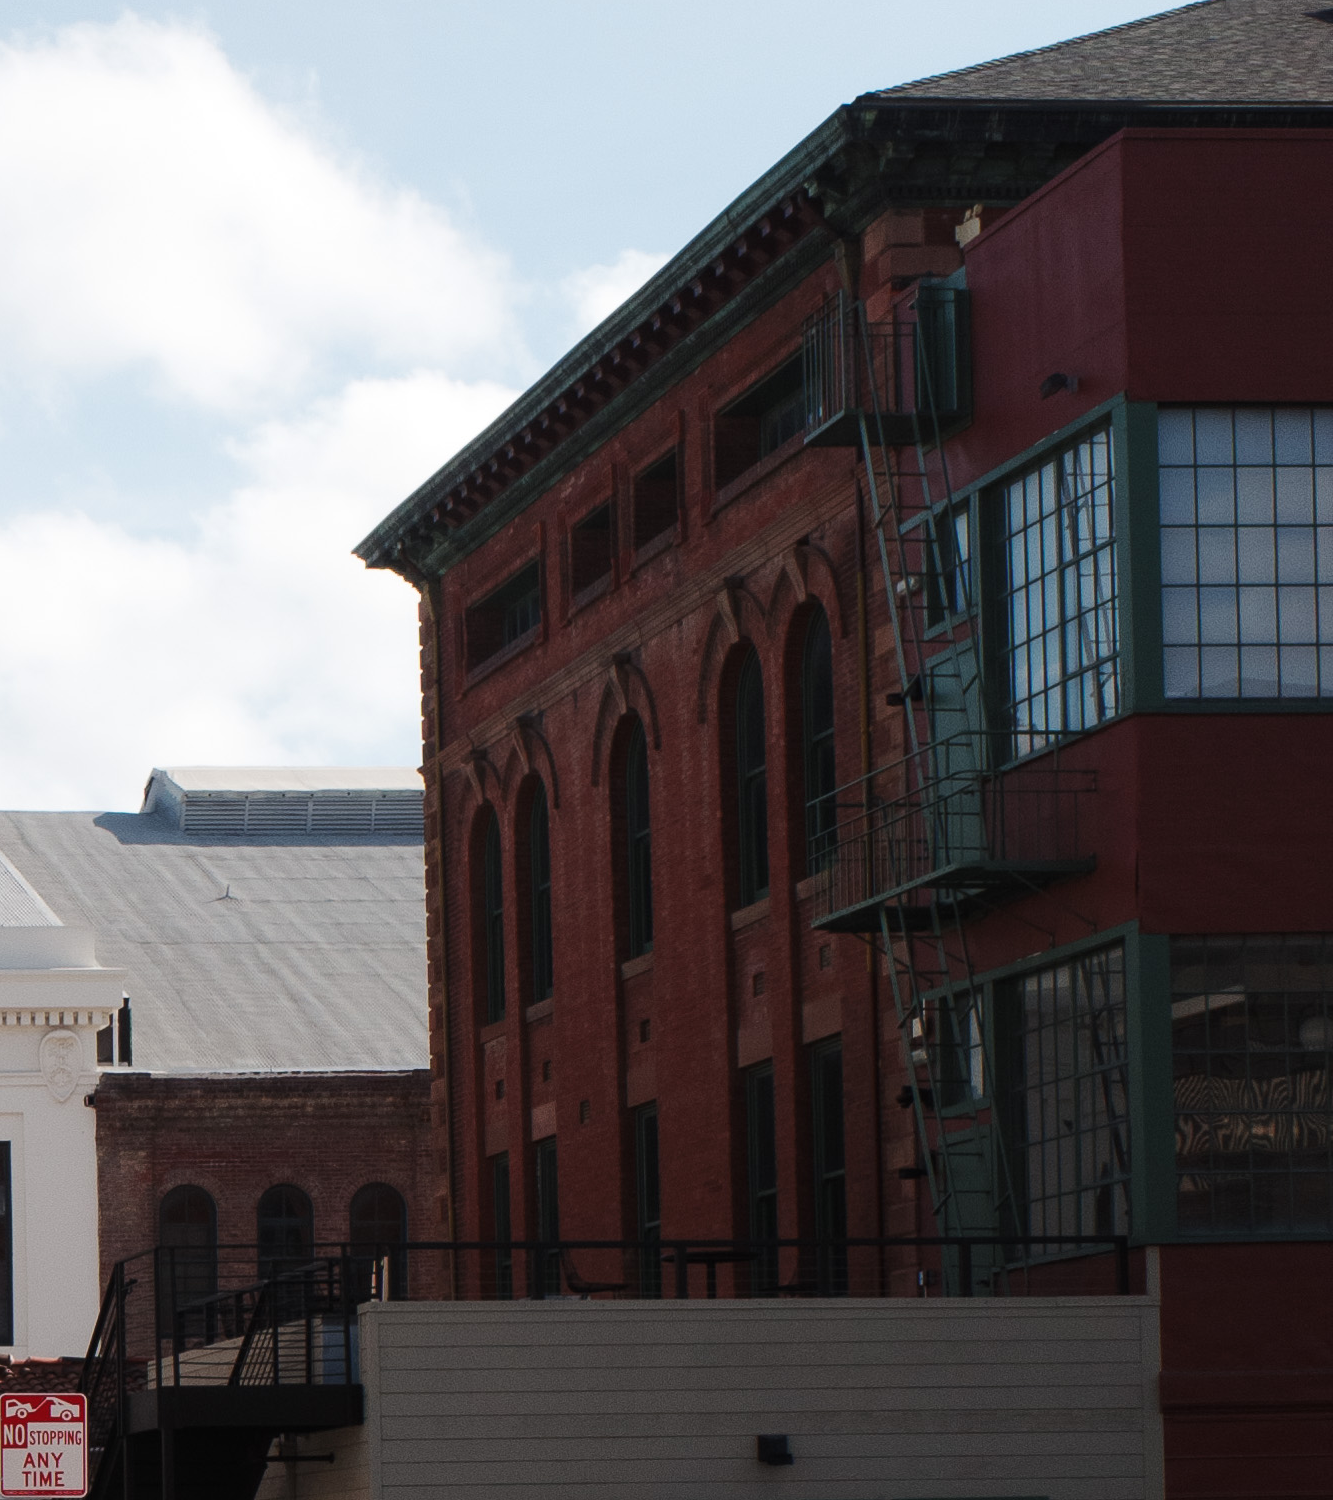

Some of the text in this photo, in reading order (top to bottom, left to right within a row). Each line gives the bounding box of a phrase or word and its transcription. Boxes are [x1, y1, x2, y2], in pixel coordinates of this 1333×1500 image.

[3, 1423, 82, 1446] NO STOPPING
[23, 1452, 63, 1468] ANY
[21, 1471, 65, 1487] TIME
